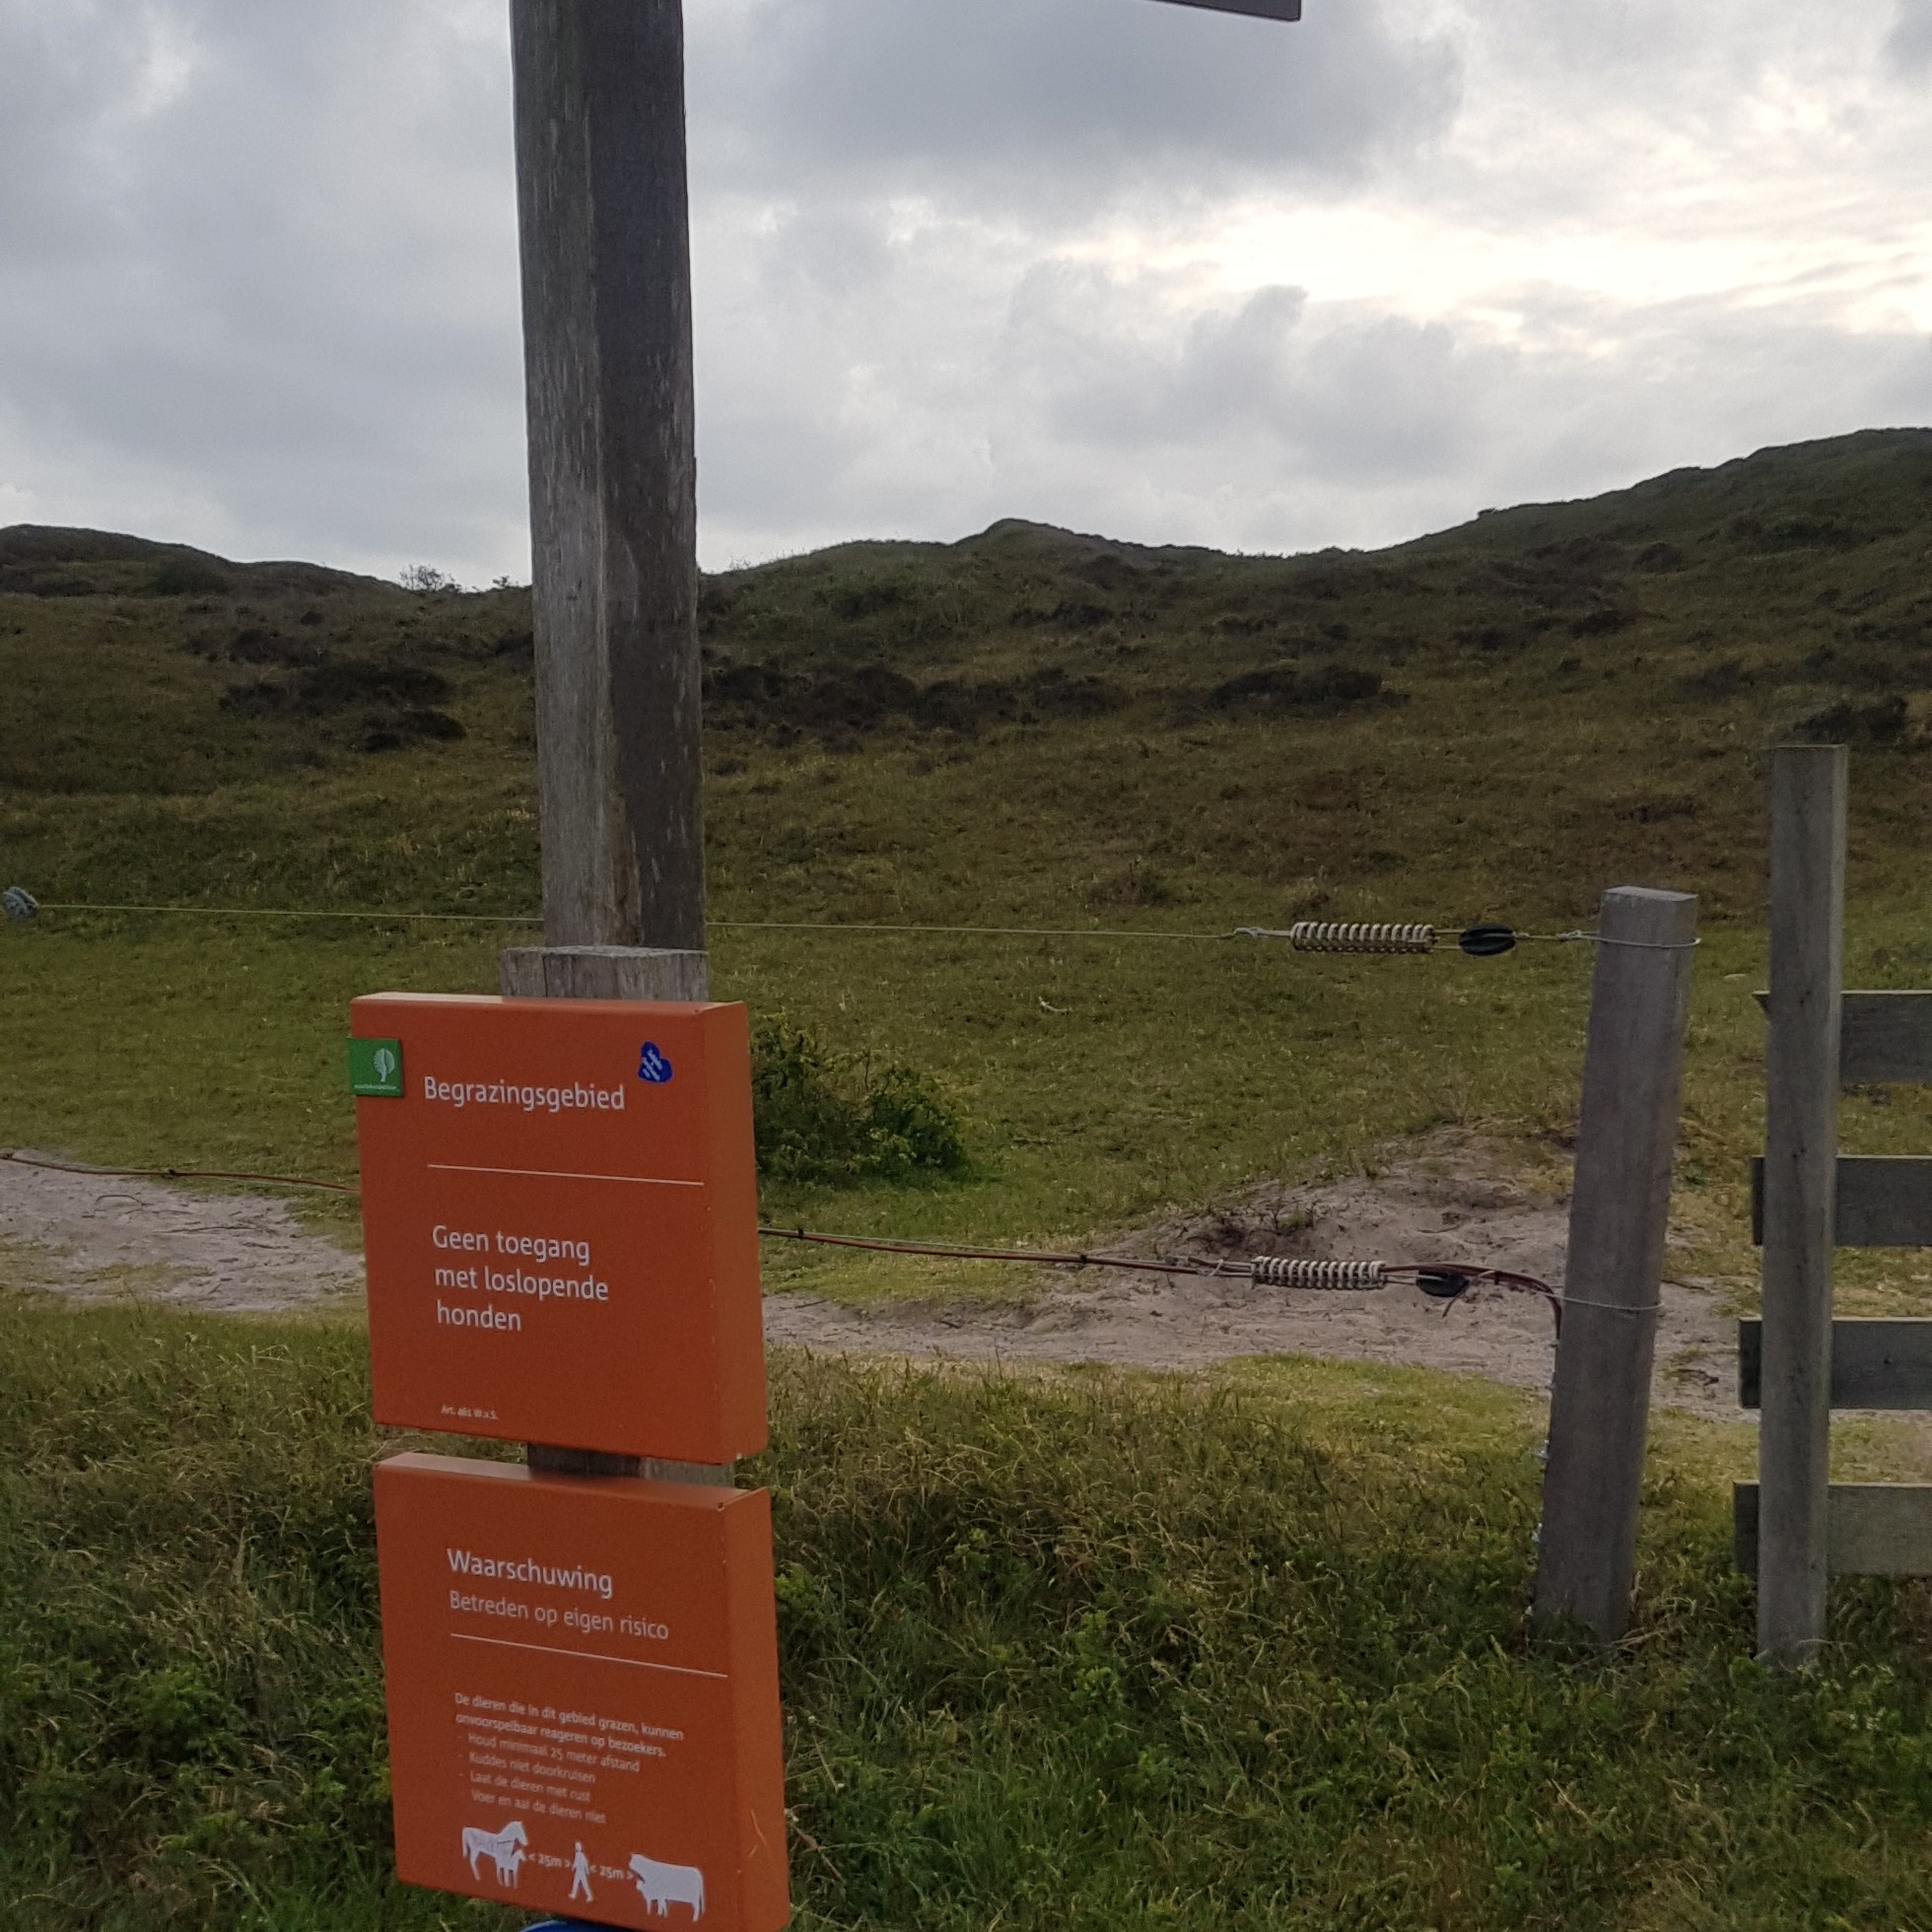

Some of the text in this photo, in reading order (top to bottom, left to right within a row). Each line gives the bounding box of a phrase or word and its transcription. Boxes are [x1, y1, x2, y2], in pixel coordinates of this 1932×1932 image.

[424, 1075, 625, 1113] Begrazingsgebied
[432, 1224, 589, 1267] Geen toegang
[435, 1266, 608, 1301] met loslopende
[437, 1299, 521, 1331] honden
[447, 1548, 612, 1599] Waarschuwing
[449, 1590, 668, 1639] Betreden op eigen risico
[455, 1692, 684, 1741] De dieren die in dit gebied grazen, kunnen
[456, 1714, 537, 1735] onvoorspelbaar
[540, 1727, 587, 1743] reageren
[591, 1736, 605, 1749] op
[468, 1733, 641, 1771] Houd minimaal 25 meter afstand
[469, 1752, 507, 1768] Kuddes
[511, 1759, 530, 1771] niet
[470, 1770, 591, 1802] Laat de dieren met rust
[471, 1789, 495, 1803] Voer
[499, 1795, 512, 1806] en
[532, 1800, 546, 1813] de
[549, 1803, 583, 1820] dieren
[586, 1811, 605, 1824] niet
